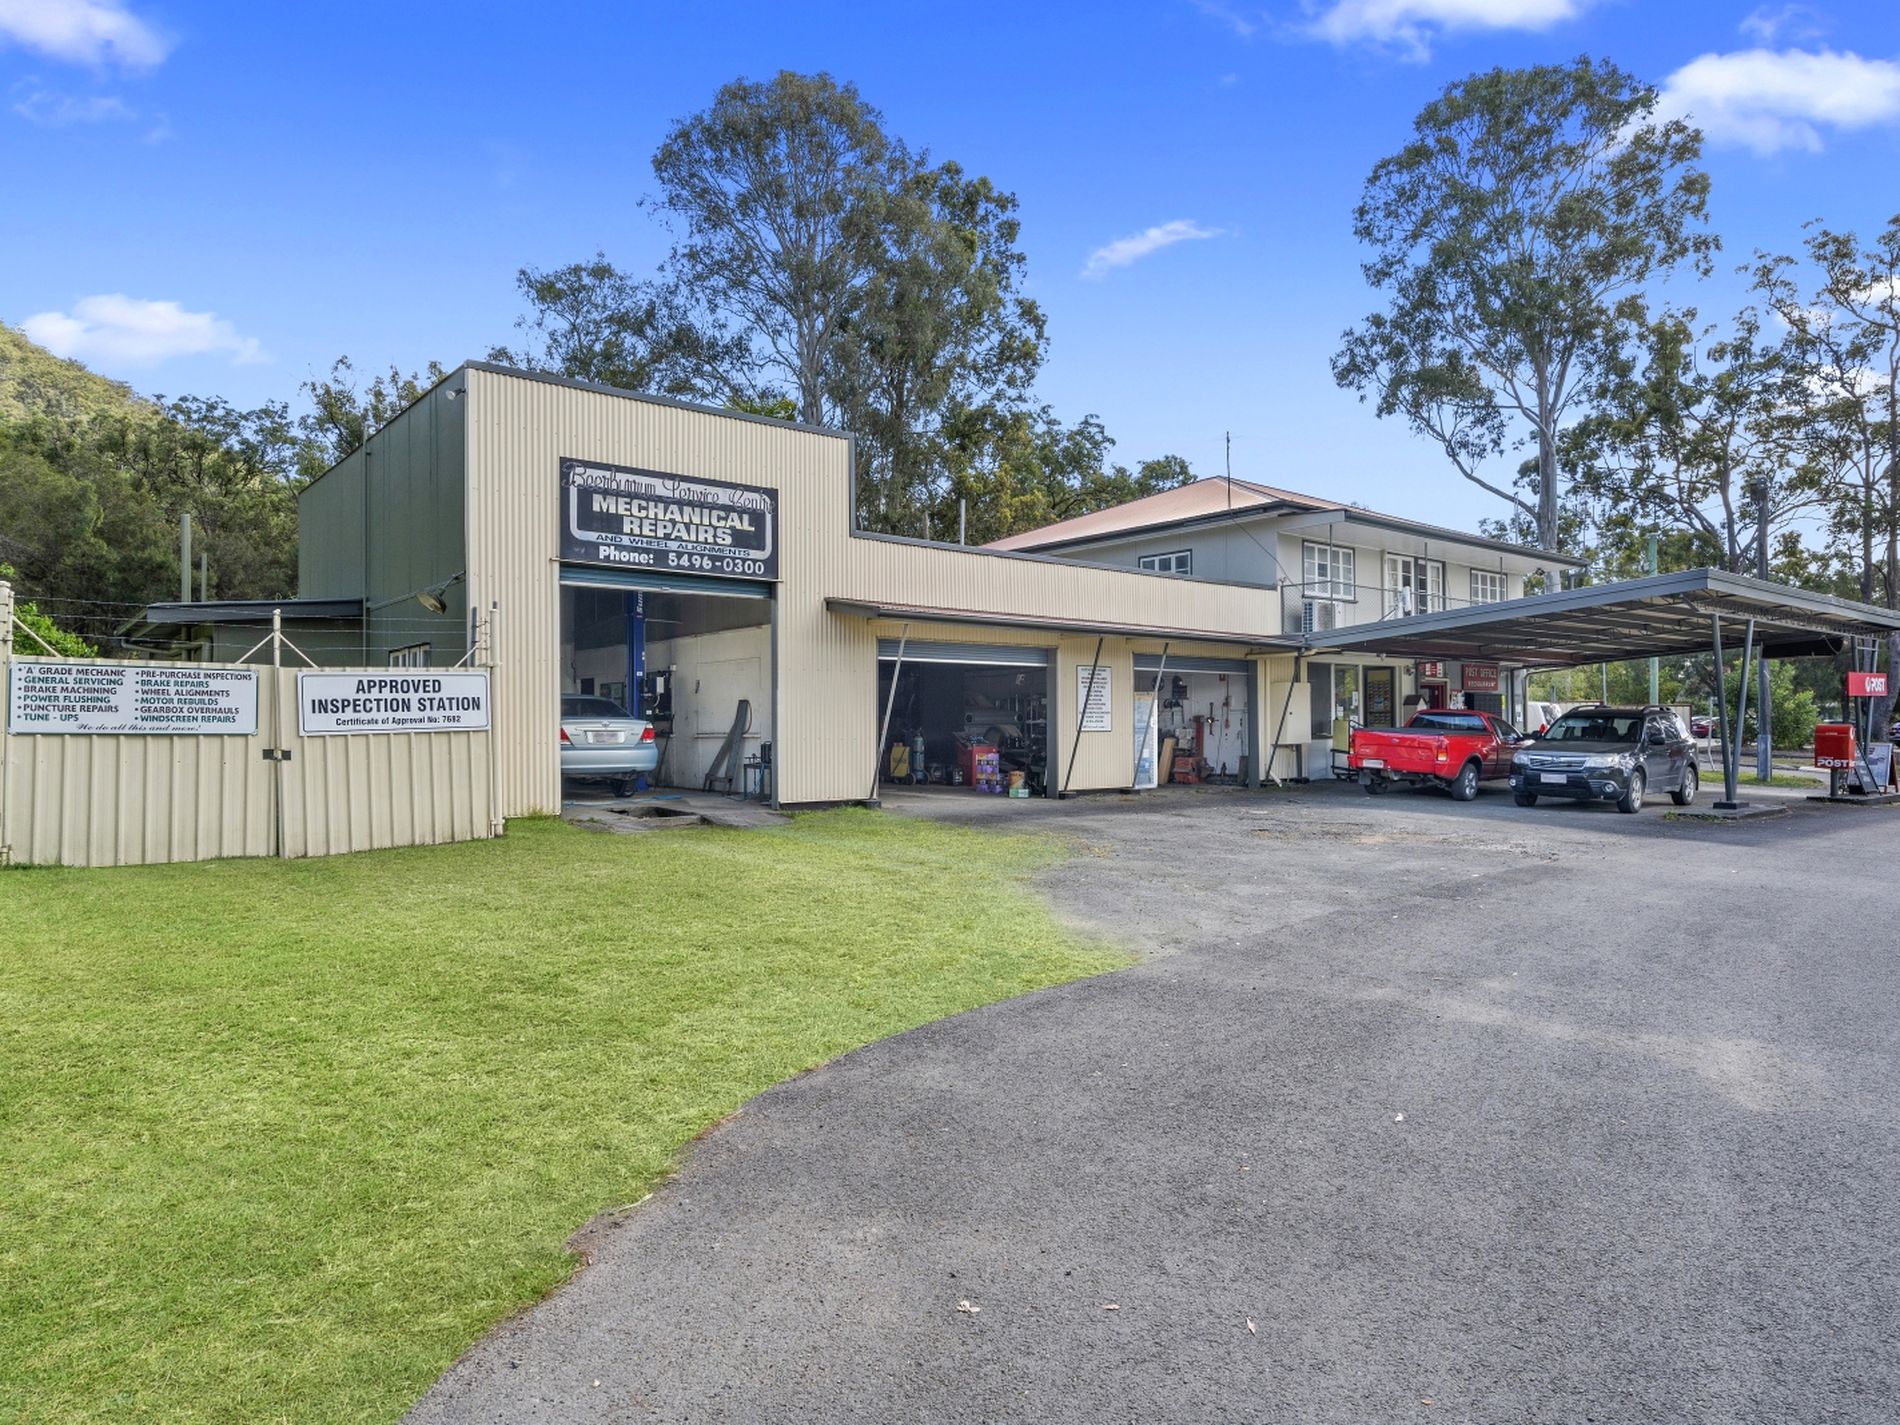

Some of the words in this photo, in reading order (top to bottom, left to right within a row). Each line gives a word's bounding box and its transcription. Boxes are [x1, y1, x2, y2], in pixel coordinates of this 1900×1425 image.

[662, 477, 719, 506] Service
[592, 493, 755, 532] MECHANICAL
[623, 516, 732, 546] REPAIRS
[596, 534, 622, 543] AND
[629, 538, 669, 548] WHEEL
[676, 543, 750, 557] ALIGNMENTS
[599, 545, 654, 564] Phone:
[668, 552, 764, 575] 5496-0300
[38, 667, 73, 675] GRADE
[76, 668, 126, 677] MECHANIC
[141, 670, 201, 679] PRE-PURCHASE
[203, 672, 252, 680] INSPECTIONS
[24, 676, 70, 685] GENERAL
[73, 677, 123, 686] SERVICING
[141, 679, 171, 687] BRAKE
[173, 680, 209, 688] REPAIRS
[23, 685, 57, 693] BRAKE
[60, 686, 117, 695] MACHINING
[355, 679, 441, 694] APPROVED
[141, 688, 170, 696] WHEEL
[174, 689, 230, 697] ALIGNMENTS
[23, 694, 60, 703] POWER
[63, 695, 110, 704] FLUSHING
[140, 697, 174, 705] MOTOR
[177, 698, 218, 706] REBUILDS
[23, 704, 76, 712] PUNCTURE
[80, 704, 119, 713] REPAIRS
[311, 698, 411, 714] INSPECTION
[417, 696, 481, 712] STATION
[140, 706, 184, 714] GEARBOX
[187, 707, 240, 715] OVERHAULS
[24, 713, 50, 721] TUNE
[140, 715, 198, 723] WINDSCREEN
[201, 715, 236, 723] REPAIRS
[335, 717, 379, 726] Certificate
[381, 717, 389, 725] of
[391, 715, 425, 725] Approval
[427, 716, 440, 724] No:
[128, 723, 146, 731] this
[1817, 759, 1849, 767] POST
